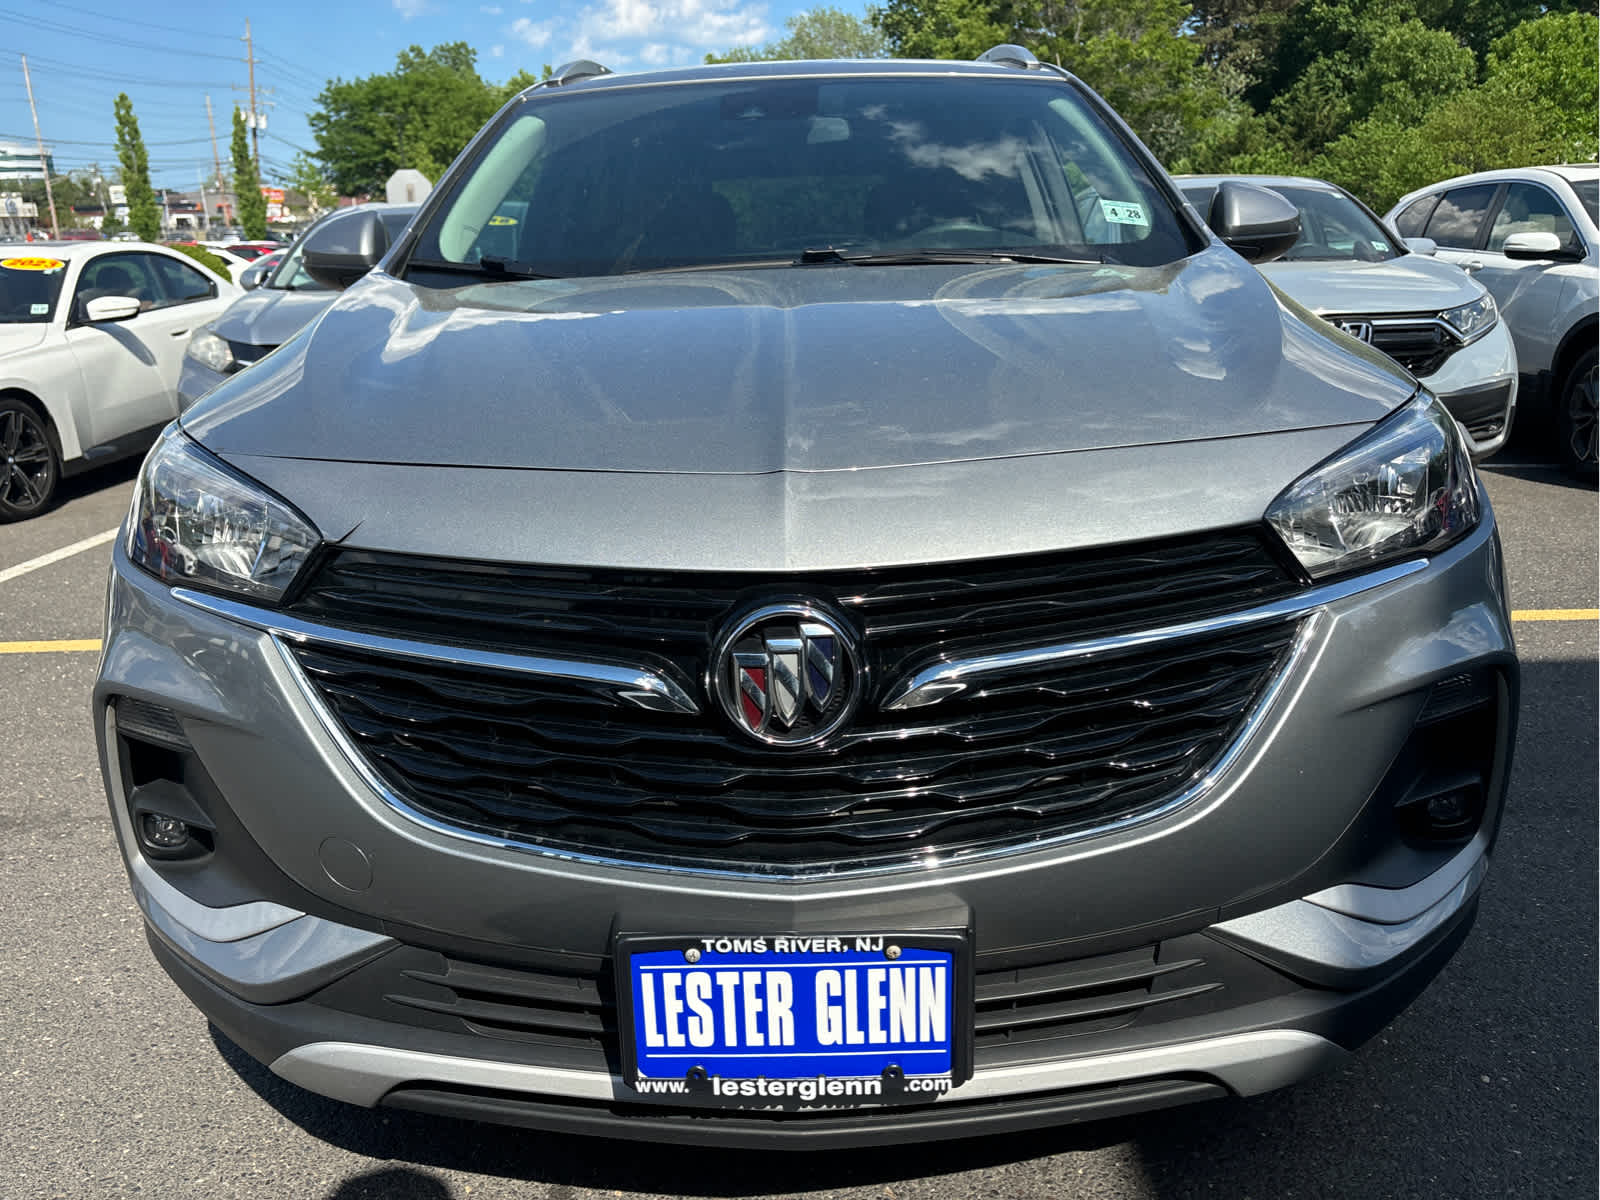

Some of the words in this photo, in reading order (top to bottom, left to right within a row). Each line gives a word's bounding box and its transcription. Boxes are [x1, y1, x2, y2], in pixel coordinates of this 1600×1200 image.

[1126, 209, 1141, 218] 28
[702, 938, 767, 953] TOMS
[774, 938, 848, 953] RIVER,
[856, 937, 884, 952] NJ
[640, 970, 795, 1048] LESTER
[815, 966, 947, 1046] GLENN
[635, 1079, 690, 1093] www.
[713, 1076, 882, 1100] lesterglenn
[903, 1077, 953, 1092] .com
